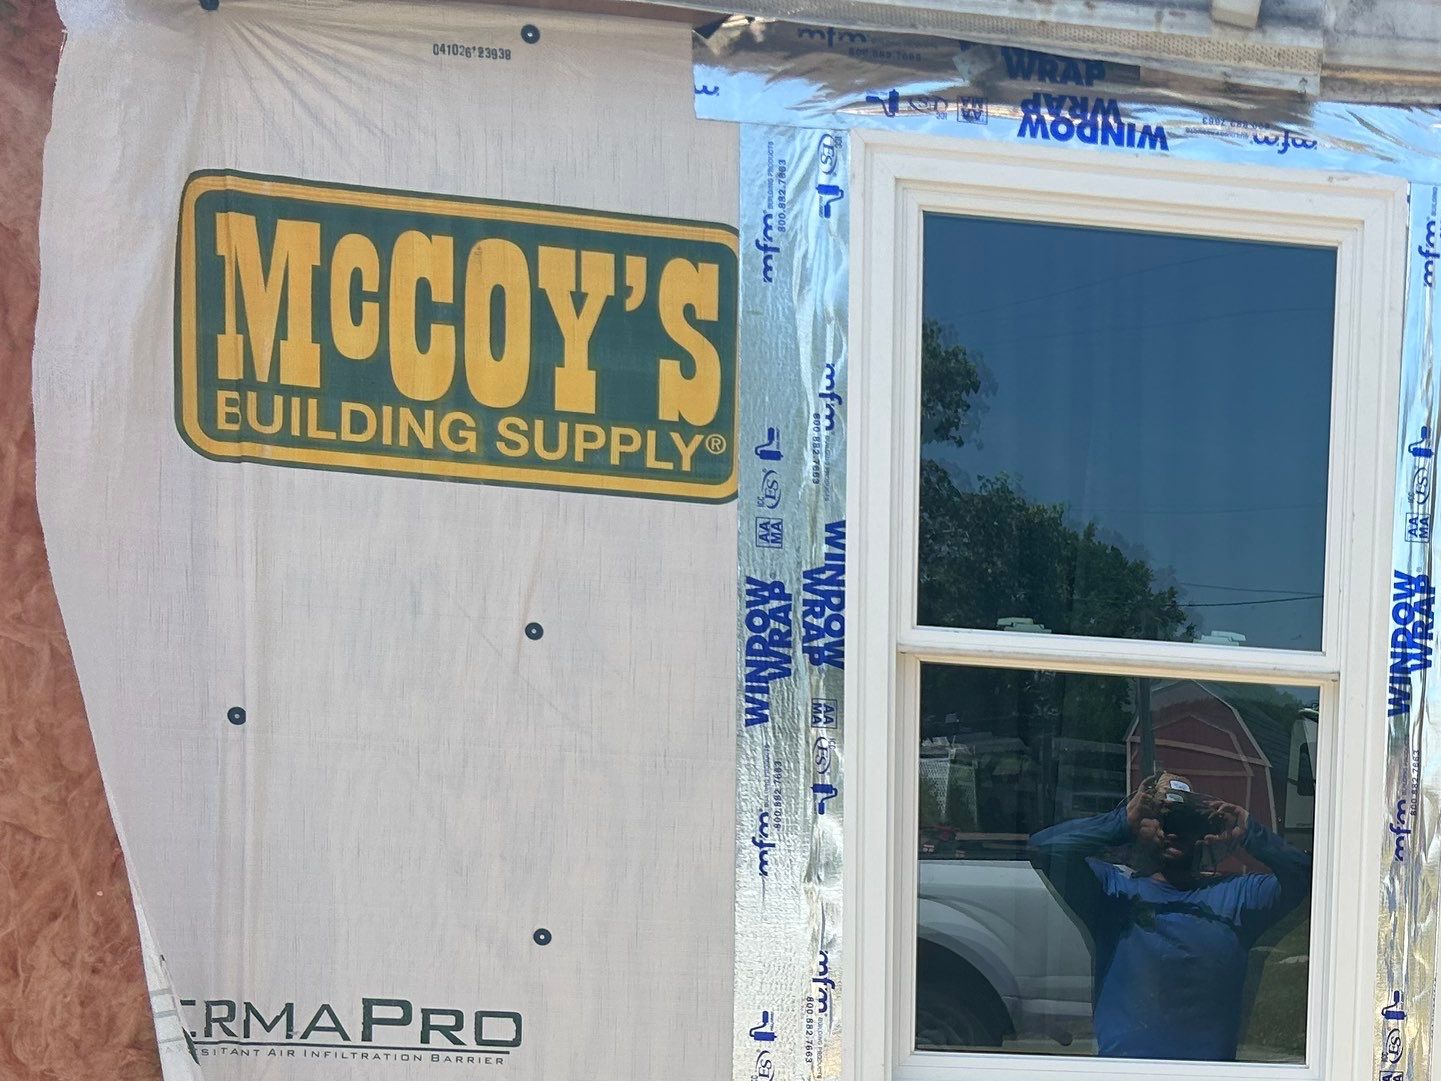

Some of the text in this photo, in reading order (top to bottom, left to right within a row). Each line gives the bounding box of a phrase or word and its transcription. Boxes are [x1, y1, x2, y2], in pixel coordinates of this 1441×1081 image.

[1003, 53, 1106, 88] WRAP
[1017, 114, 1170, 151] WINDOW
[1020, 91, 1124, 124] WRAP
[1252, 130, 1318, 155] mfm
[776, 159, 787, 233] 800.882.7663
[755, 213, 781, 283] mfm
[1418, 220, 1441, 287] mfm
[215, 210, 721, 427] McCOY'S
[216, 389, 477, 455] BUILDING
[819, 363, 843, 431] mfm
[765, 479, 780, 501] ES
[758, 520, 770, 544] AA
[770, 520, 782, 545] MA
[1407, 516, 1419, 538] AA
[1418, 516, 1430, 539] MA
[802, 565, 828, 668] WRAP
[823, 519, 847, 671] WINDOW
[1409, 574, 1436, 672] WRAP
[745, 575, 771, 728] WINDOW
[768, 580, 793, 682] WRAP
[1387, 569, 1416, 718] WINDOW
[812, 701, 823, 725] MA
[823, 702, 834, 725] AA
[752, 811, 776, 877] mfm
[1390, 799, 1412, 861] mfm
[812, 950, 836, 1014] mfm
[268, 1047, 296, 1058] AIR
[303, 1049, 422, 1063] INFILTRATION
[430, 1053, 505, 1066] BARRIER
[758, 1058, 773, 1079] ES
